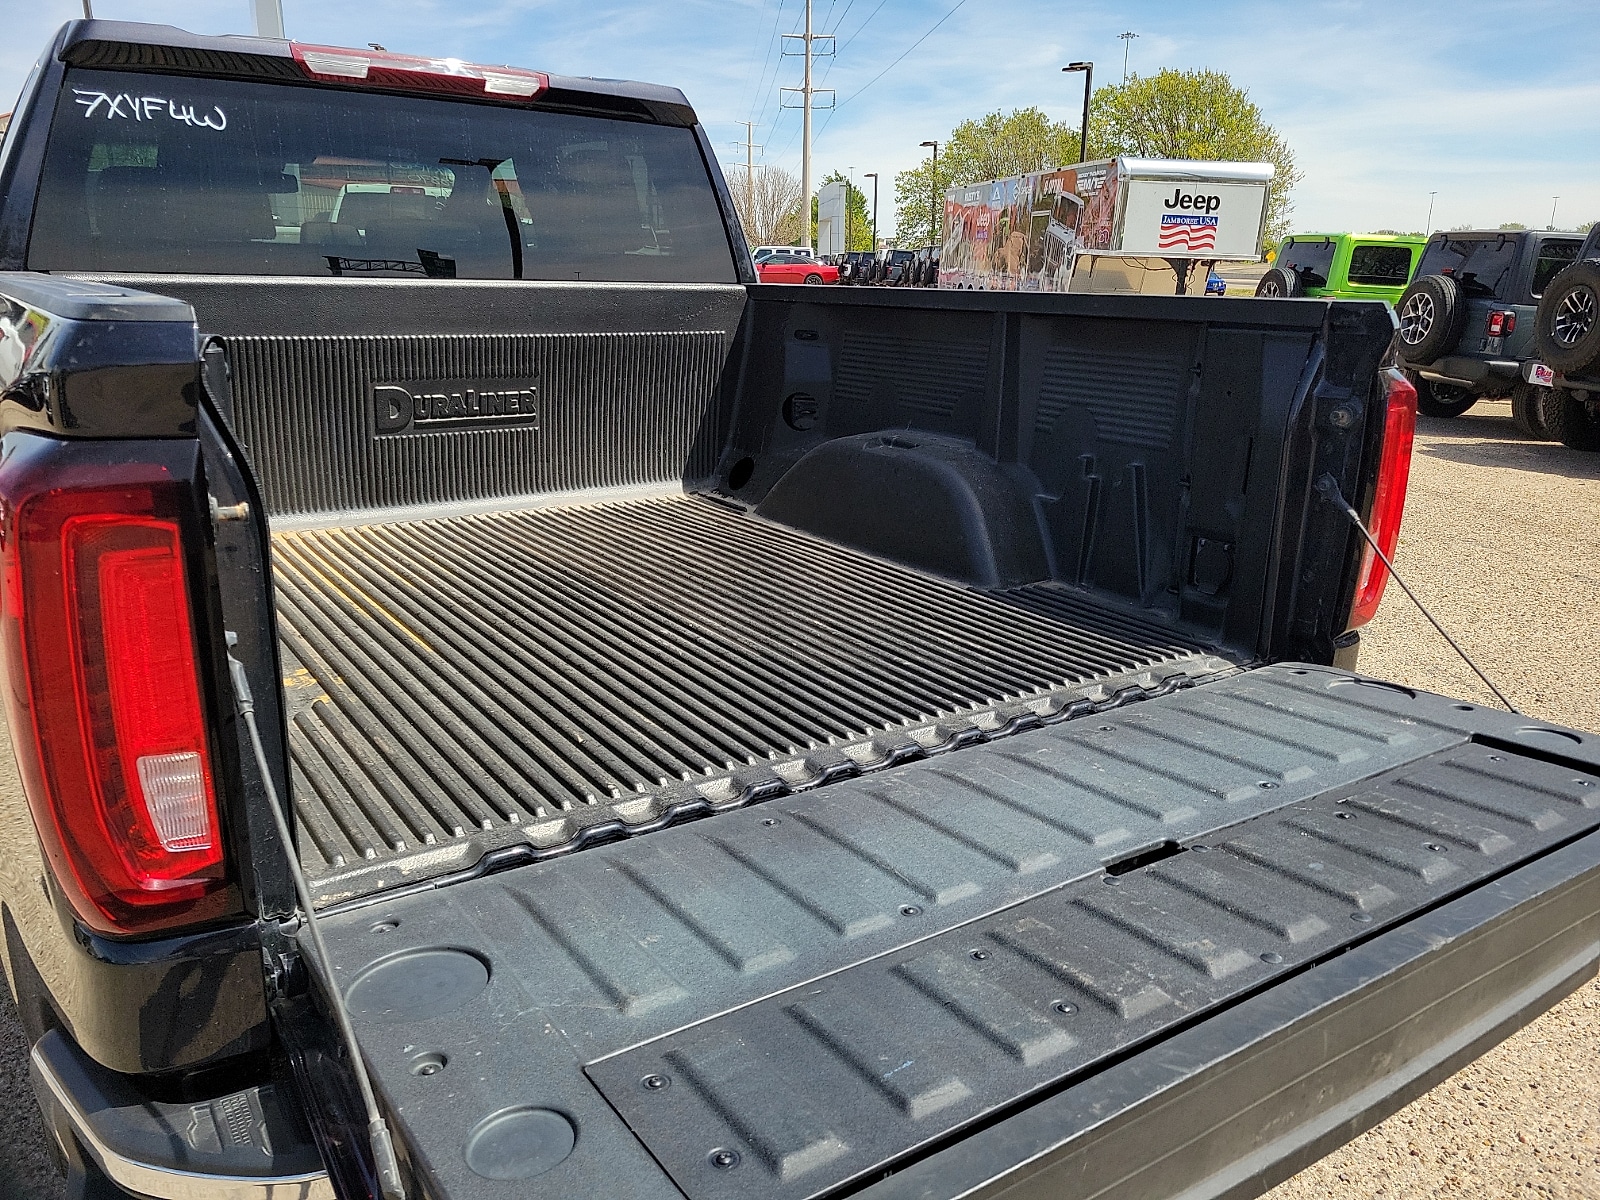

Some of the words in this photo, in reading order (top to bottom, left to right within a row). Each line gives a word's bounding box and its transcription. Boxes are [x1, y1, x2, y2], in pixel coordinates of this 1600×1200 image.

[1164, 189, 1221, 214] Jeep
[1163, 216, 1199, 224] JAMBOREE
[1200, 216, 1217, 226] USA
[374, 386, 536, 434] DURALINER
